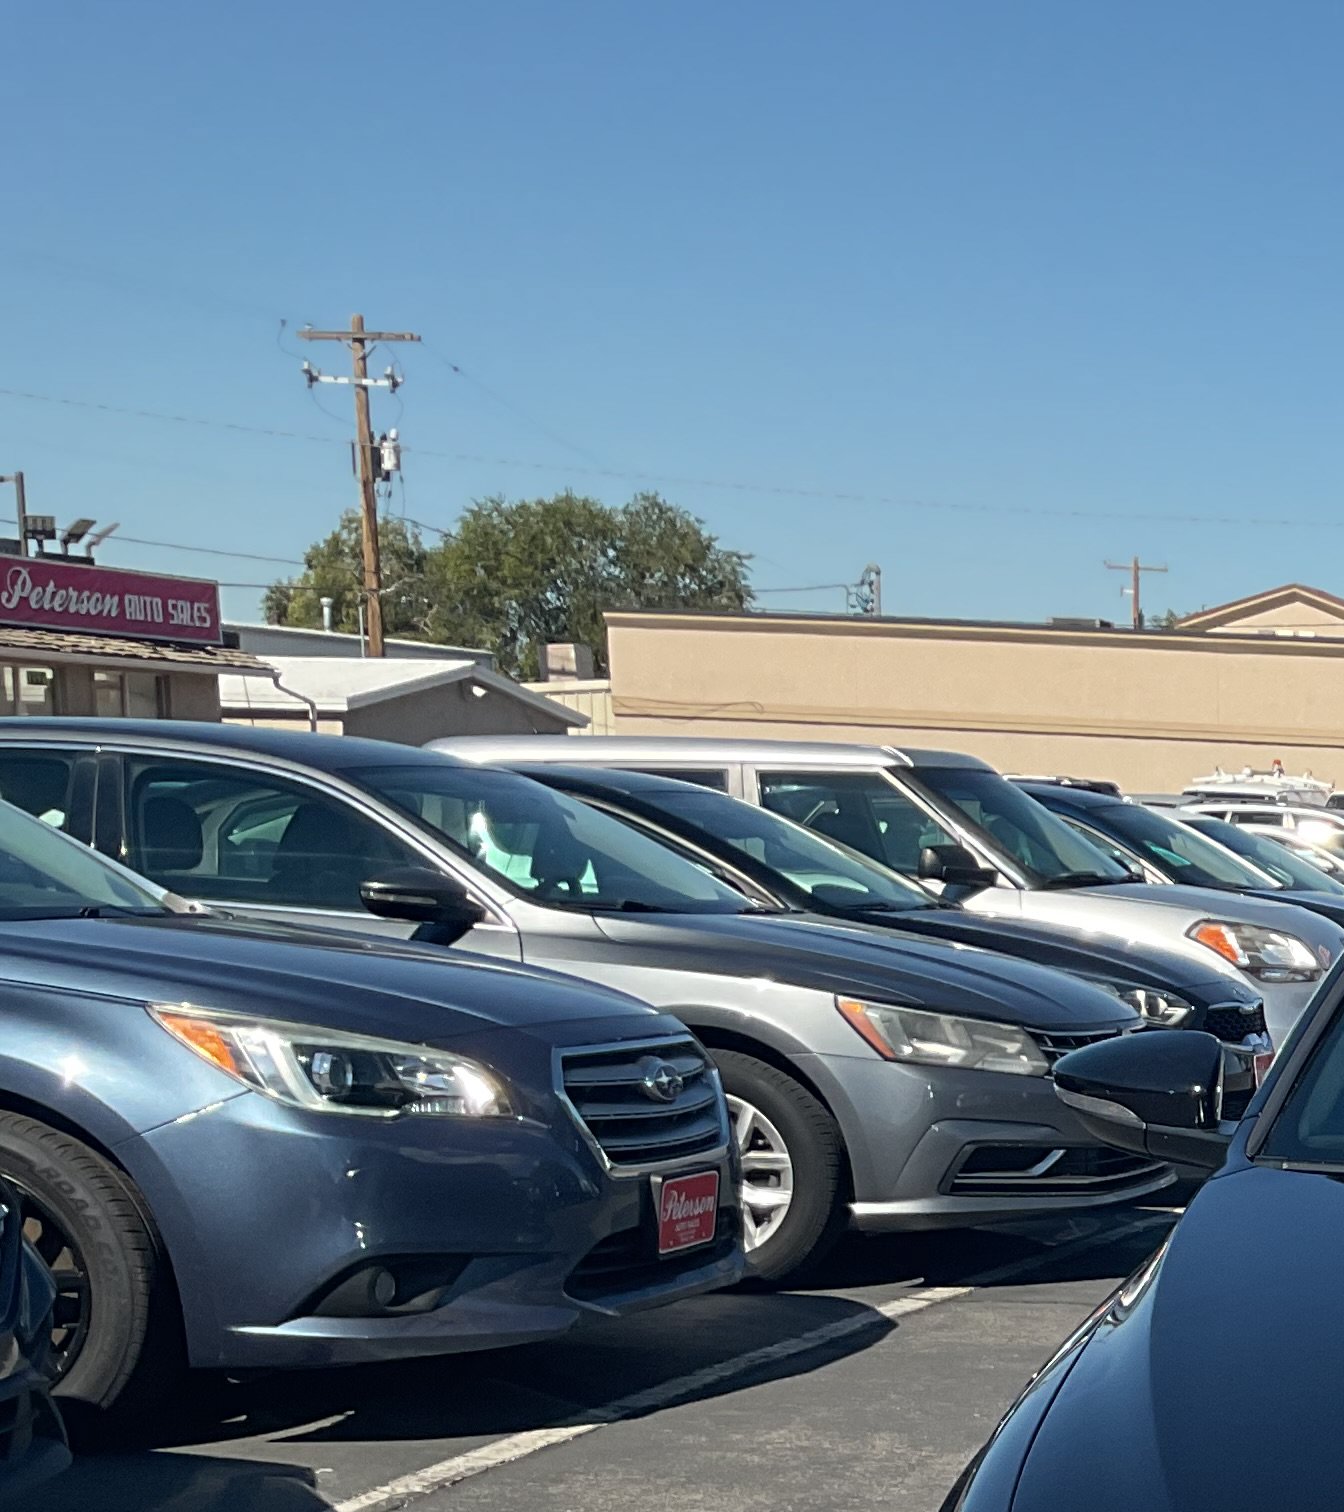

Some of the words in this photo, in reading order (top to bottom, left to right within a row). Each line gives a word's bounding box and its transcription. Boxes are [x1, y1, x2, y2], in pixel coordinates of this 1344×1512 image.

[1, 566, 120, 617] Peterson
[124, 593, 163, 624] AUTO
[168, 599, 211, 628] SALES
[663, 1190, 714, 1222] Peterson
